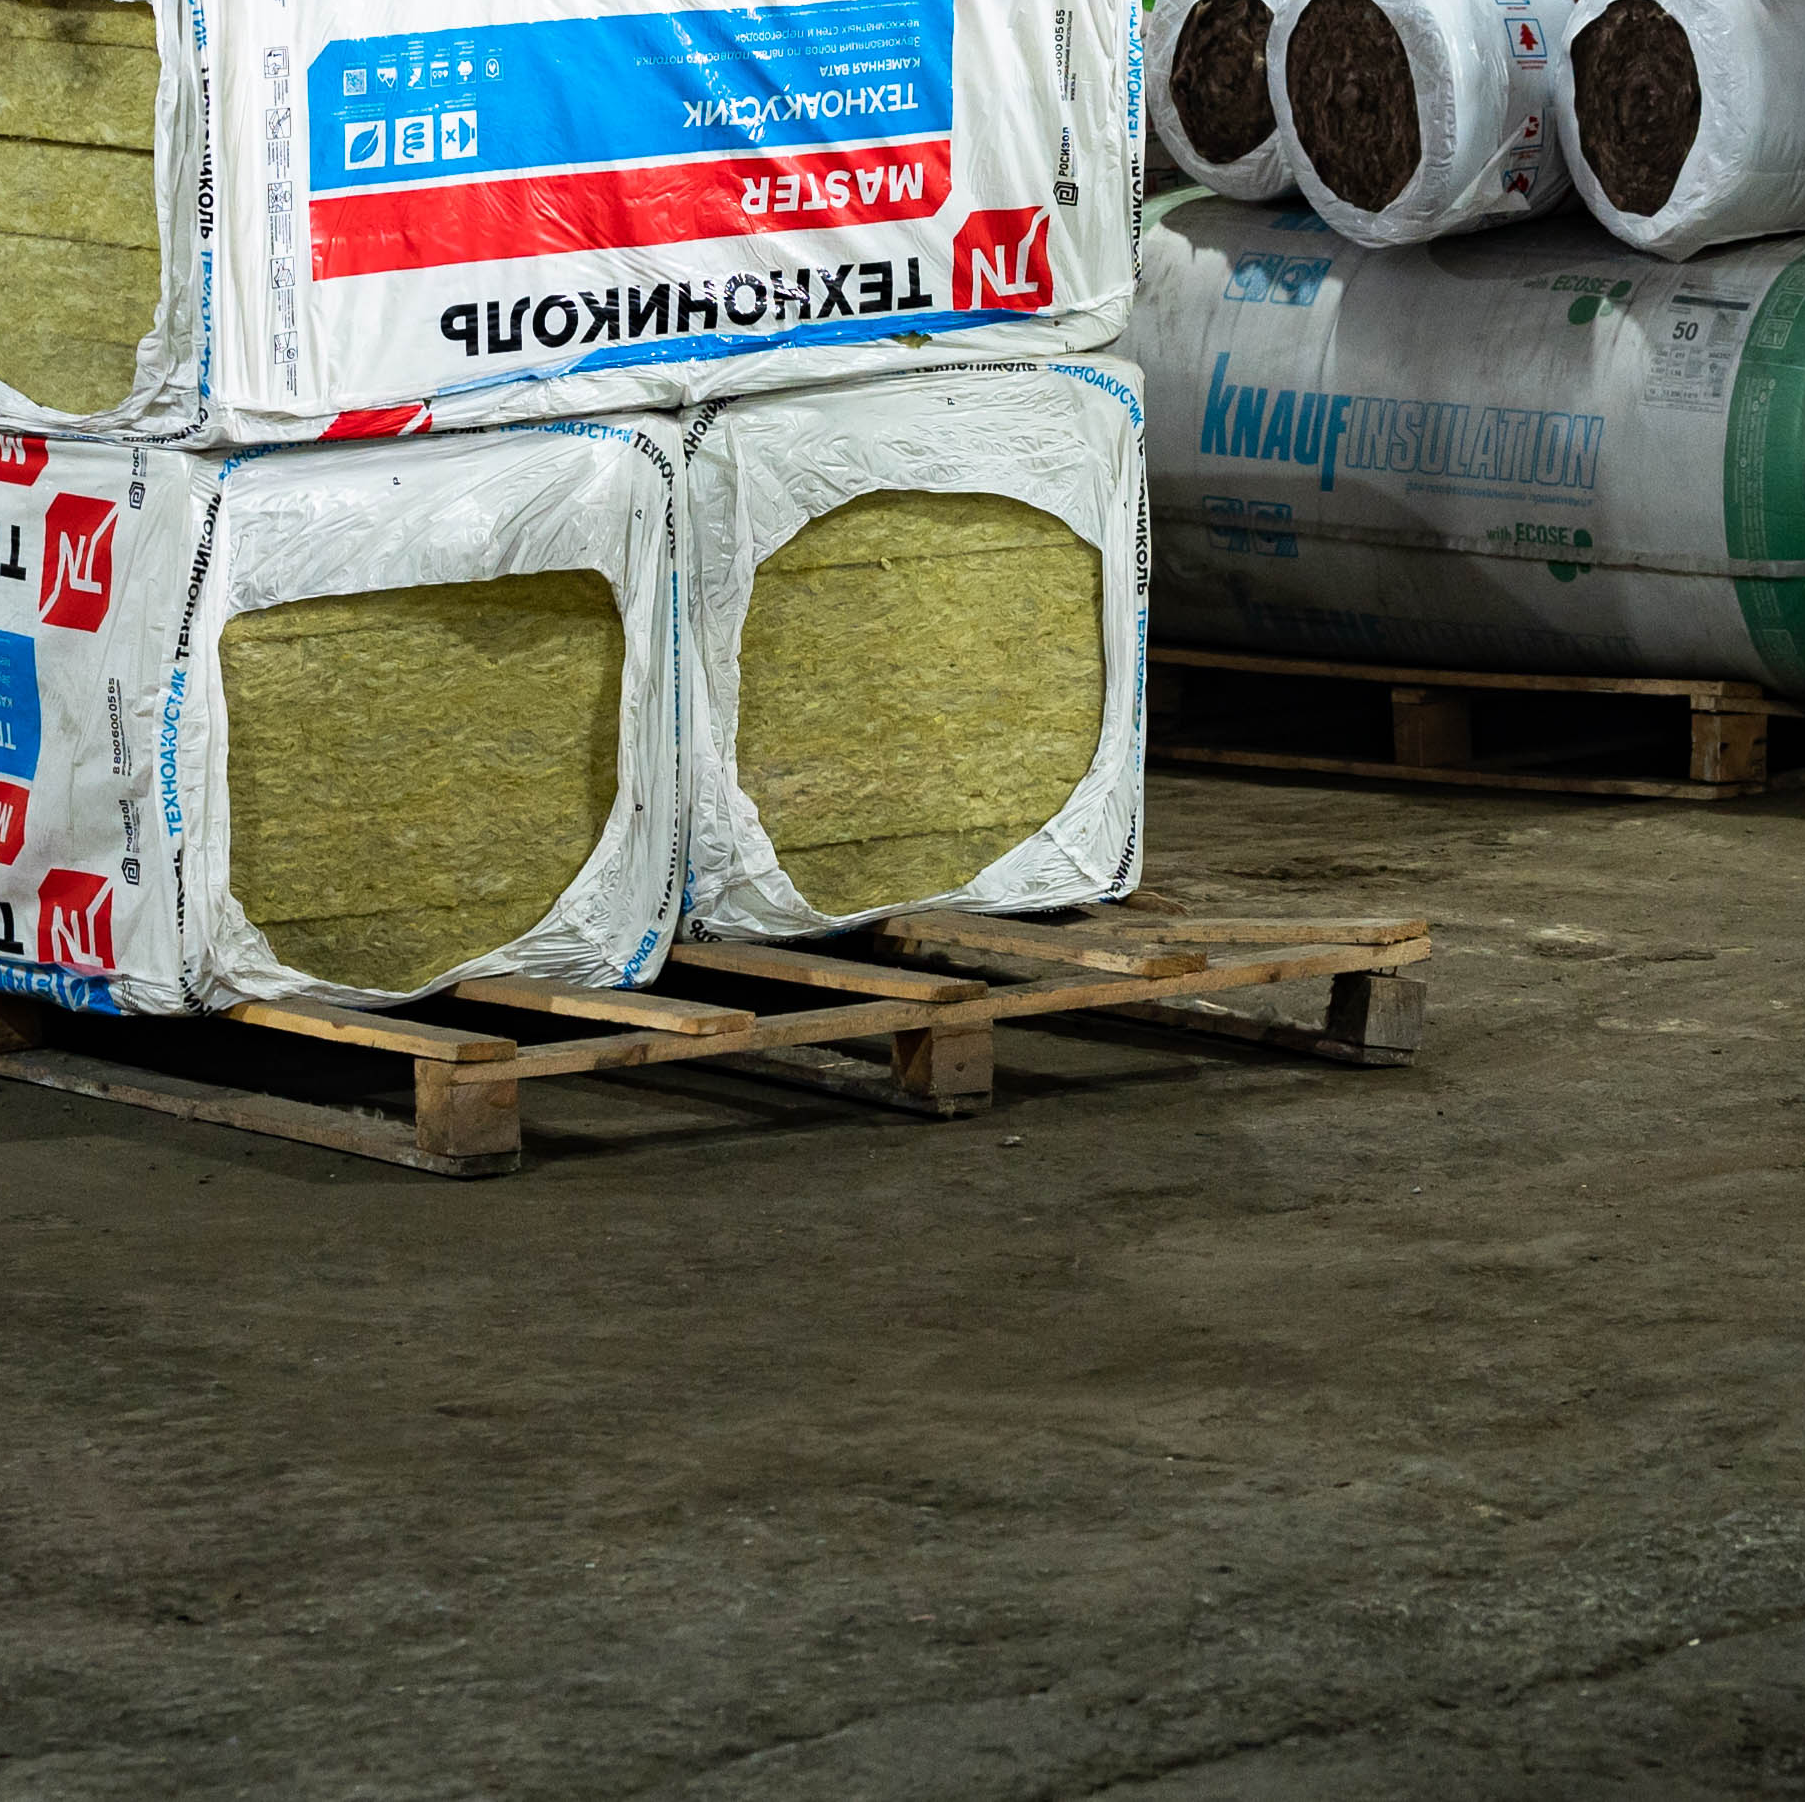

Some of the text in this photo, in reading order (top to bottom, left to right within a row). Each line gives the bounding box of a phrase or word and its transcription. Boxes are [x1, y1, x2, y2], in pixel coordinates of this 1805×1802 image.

[819, 56, 921, 77] КАМЕННАЯ ВАТА
[681, 80, 919, 128] ТЕХНОАКУСТИК
[741, 161, 926, 216] MASTER
[1550, 274, 1614, 295] ECOSE
[440, 257, 934, 357] ТЕХНОНИКОЛЬ
[1672, 321, 1699, 342] 50
[1344, 395, 1605, 490] INSULATION
[1486, 523, 1572, 547] with ECOSE
